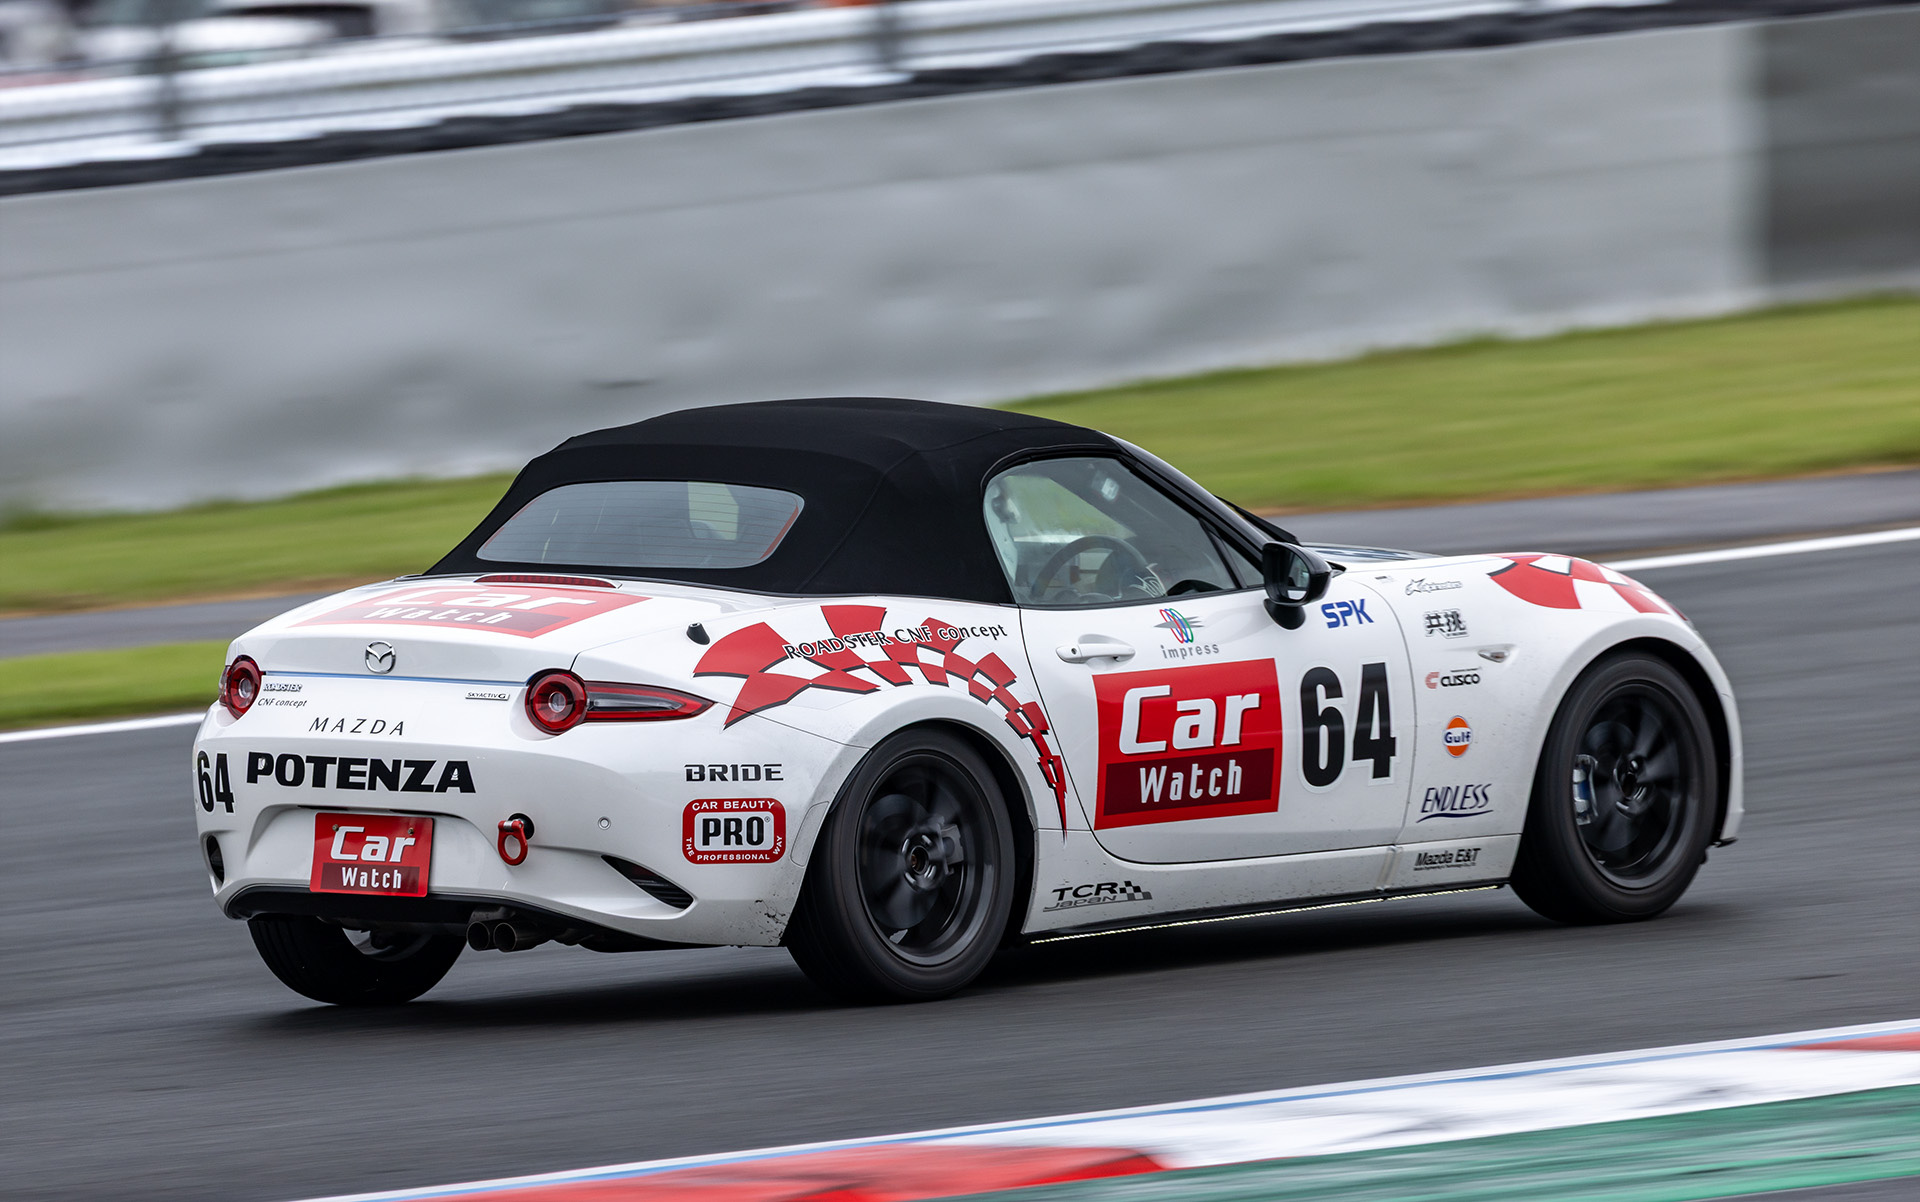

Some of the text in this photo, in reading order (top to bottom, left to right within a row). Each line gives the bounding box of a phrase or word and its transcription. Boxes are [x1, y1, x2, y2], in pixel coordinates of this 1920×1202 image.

[374, 589, 597, 610] Car
[363, 606, 514, 624] Watch
[1321, 599, 1374, 629] SPK
[784, 624, 1008, 659] ROADSTER CNF concept
[1160, 643, 1220, 659] impress
[1441, 673, 1481, 687] CUSCO
[258, 698, 308, 709] CNF concept
[309, 717, 405, 736] MAZDA
[1119, 685, 1261, 755] Car
[1300, 662, 1396, 787] 64
[1444, 731, 1472, 744] Gulf
[198, 750, 235, 814] 64
[246, 752, 476, 794] POTENZA
[684, 763, 784, 782] BRIDE
[1139, 760, 1242, 804] Watch
[692, 801, 775, 811] CAR BEAUTY
[1420, 783, 1492, 813] ENDLESS
[702, 816, 764, 846] PRO
[330, 826, 415, 862] Car
[686, 837, 695, 857] THE
[773, 835, 782, 855] WAY
[1415, 850, 1453, 866] Mazda
[342, 866, 401, 889] Watch
[1052, 882, 1118, 901] TCR
